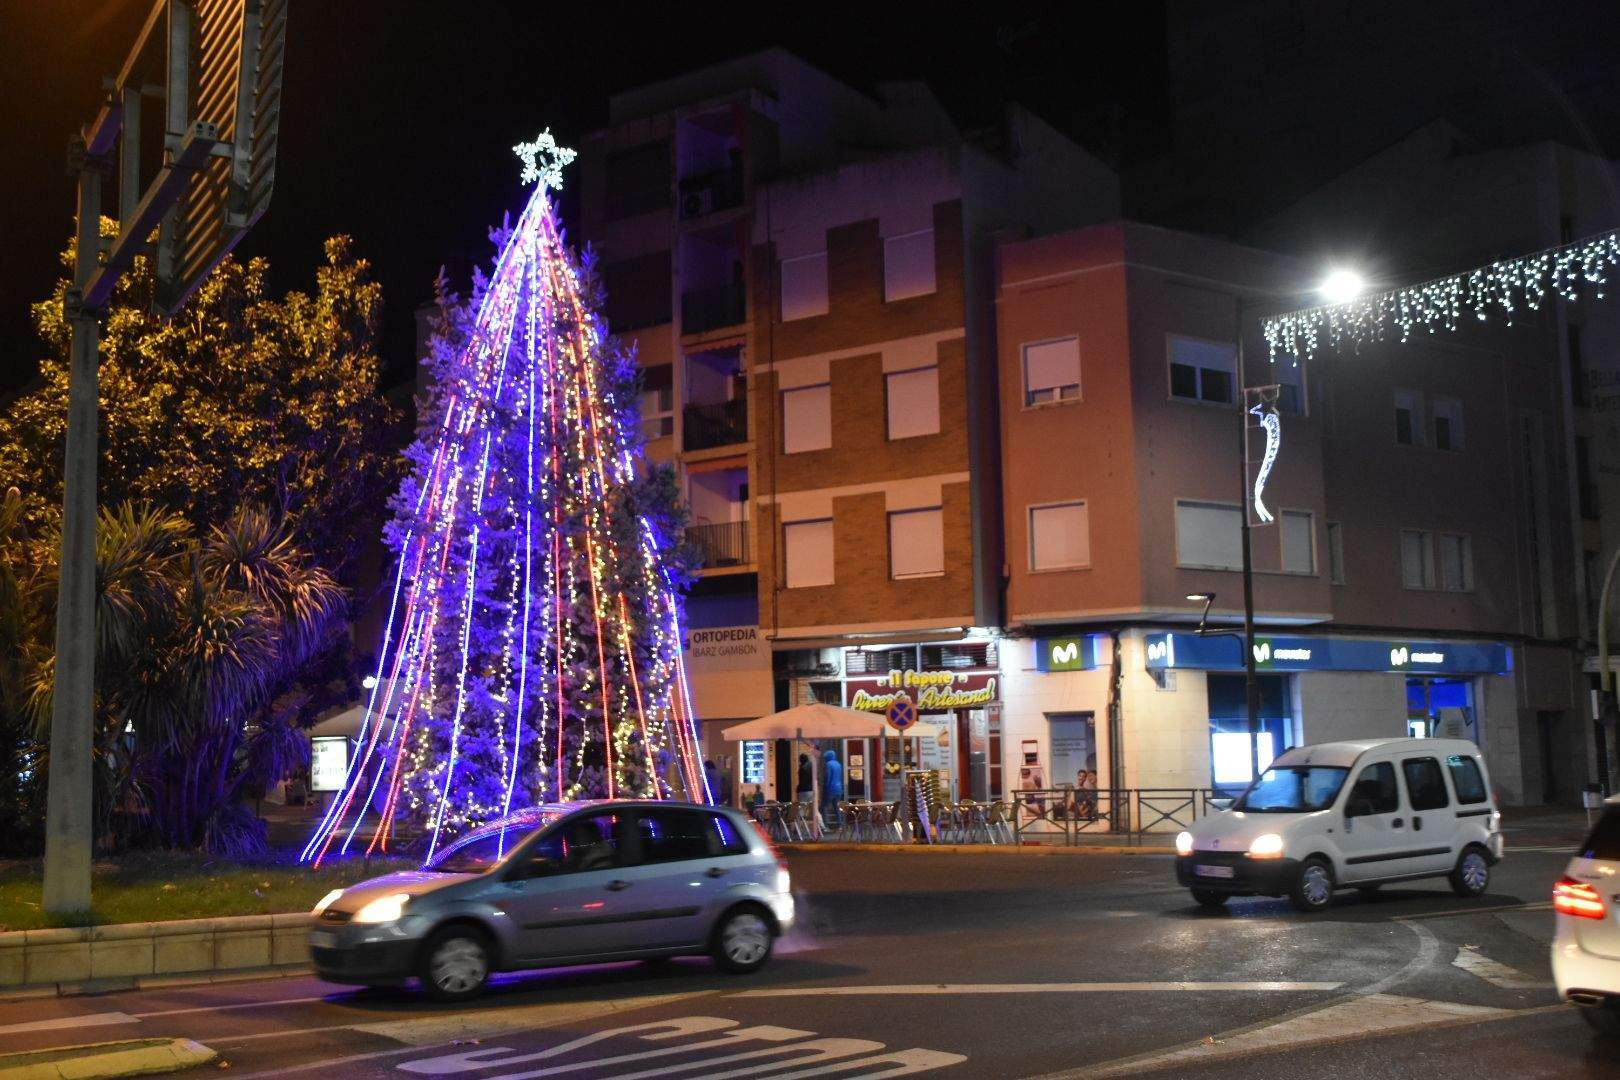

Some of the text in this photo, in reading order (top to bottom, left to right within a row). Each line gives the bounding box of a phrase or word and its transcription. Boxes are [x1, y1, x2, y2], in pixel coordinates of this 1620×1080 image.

[693, 629, 756, 643] ORTOPEDIA
[919, 678, 996, 709] Artesanal
[395, 1016, 968, 1080] STOP
